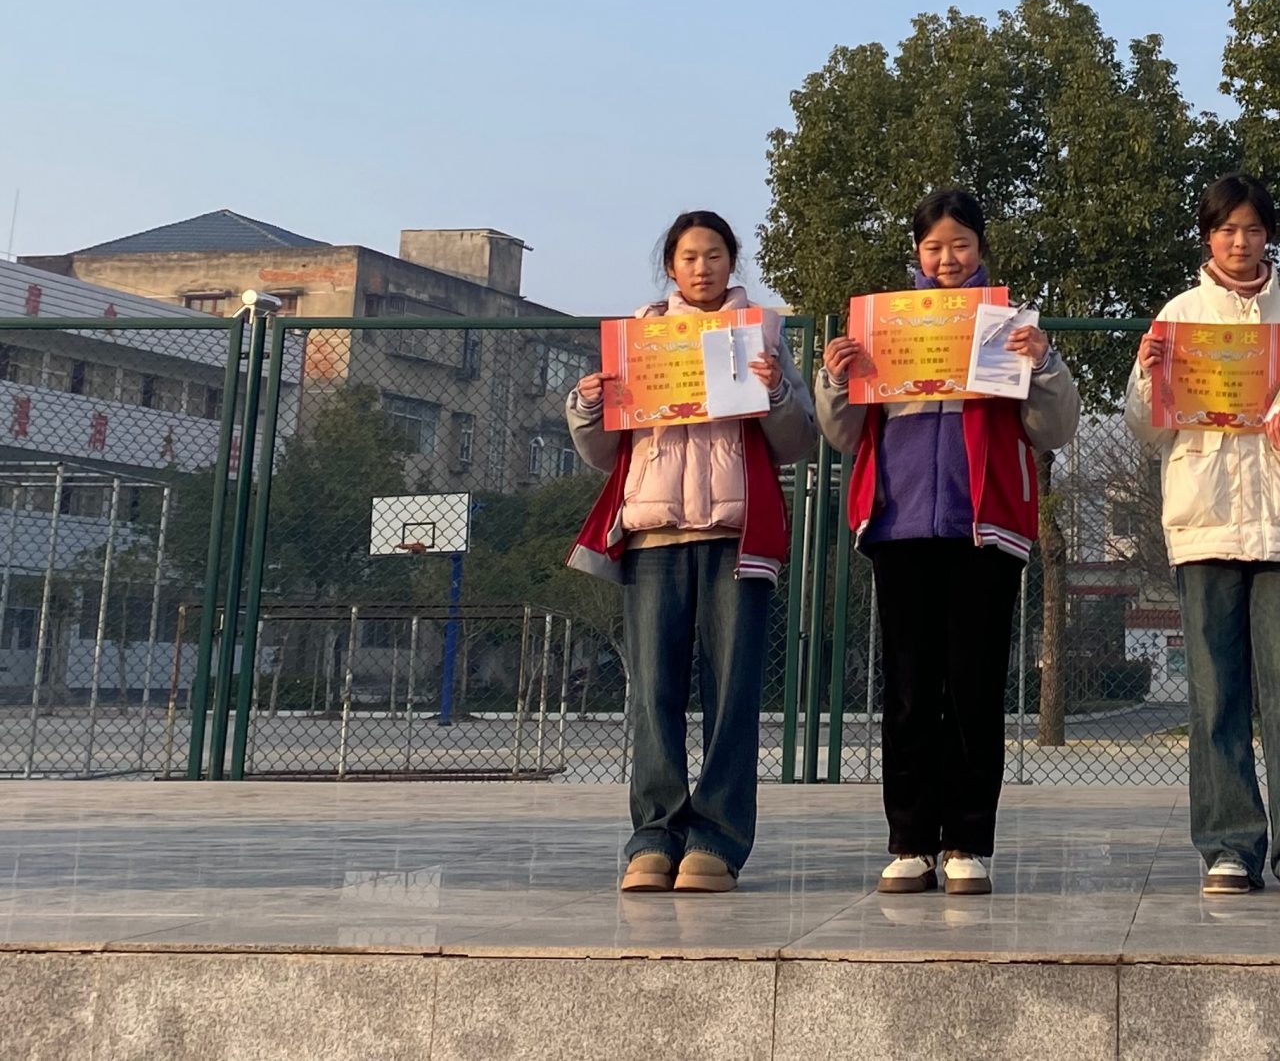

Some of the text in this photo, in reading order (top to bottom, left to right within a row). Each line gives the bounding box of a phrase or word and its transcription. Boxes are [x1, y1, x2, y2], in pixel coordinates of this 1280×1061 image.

[889, 296, 967, 312] 奖状
[643, 318, 721, 338] 奖状
[1191, 329, 1259, 344] 奖状
